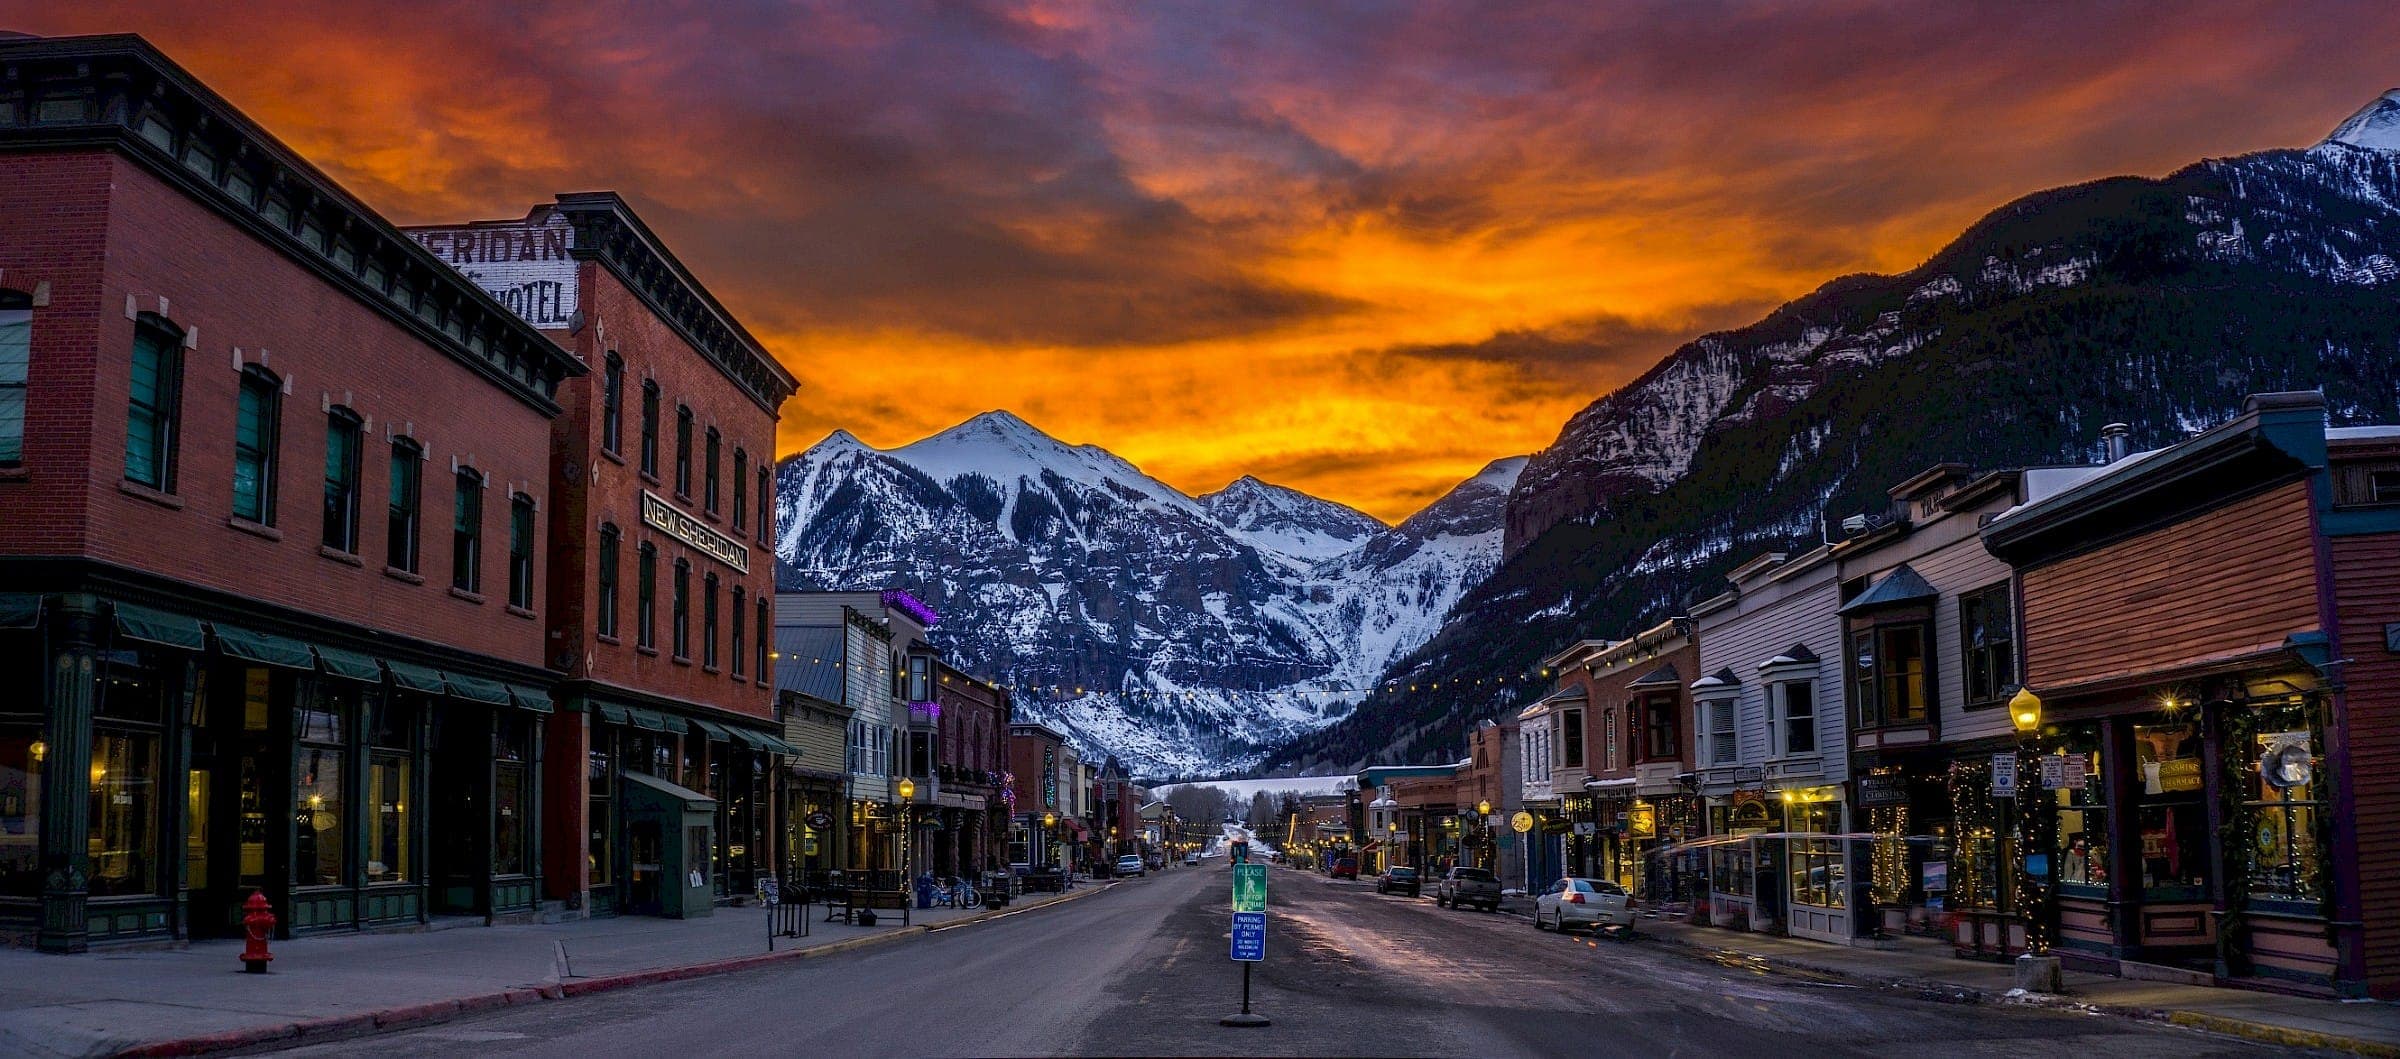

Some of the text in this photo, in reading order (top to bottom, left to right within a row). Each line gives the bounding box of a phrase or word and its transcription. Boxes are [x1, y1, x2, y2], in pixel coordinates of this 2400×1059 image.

[646, 498, 745, 568] NEW SHERIDAN
[1237, 868, 1264, 876] PLEASE
[1237, 916, 1262, 924] PARKING
[1233, 923, 1264, 931] BY PERMIT
